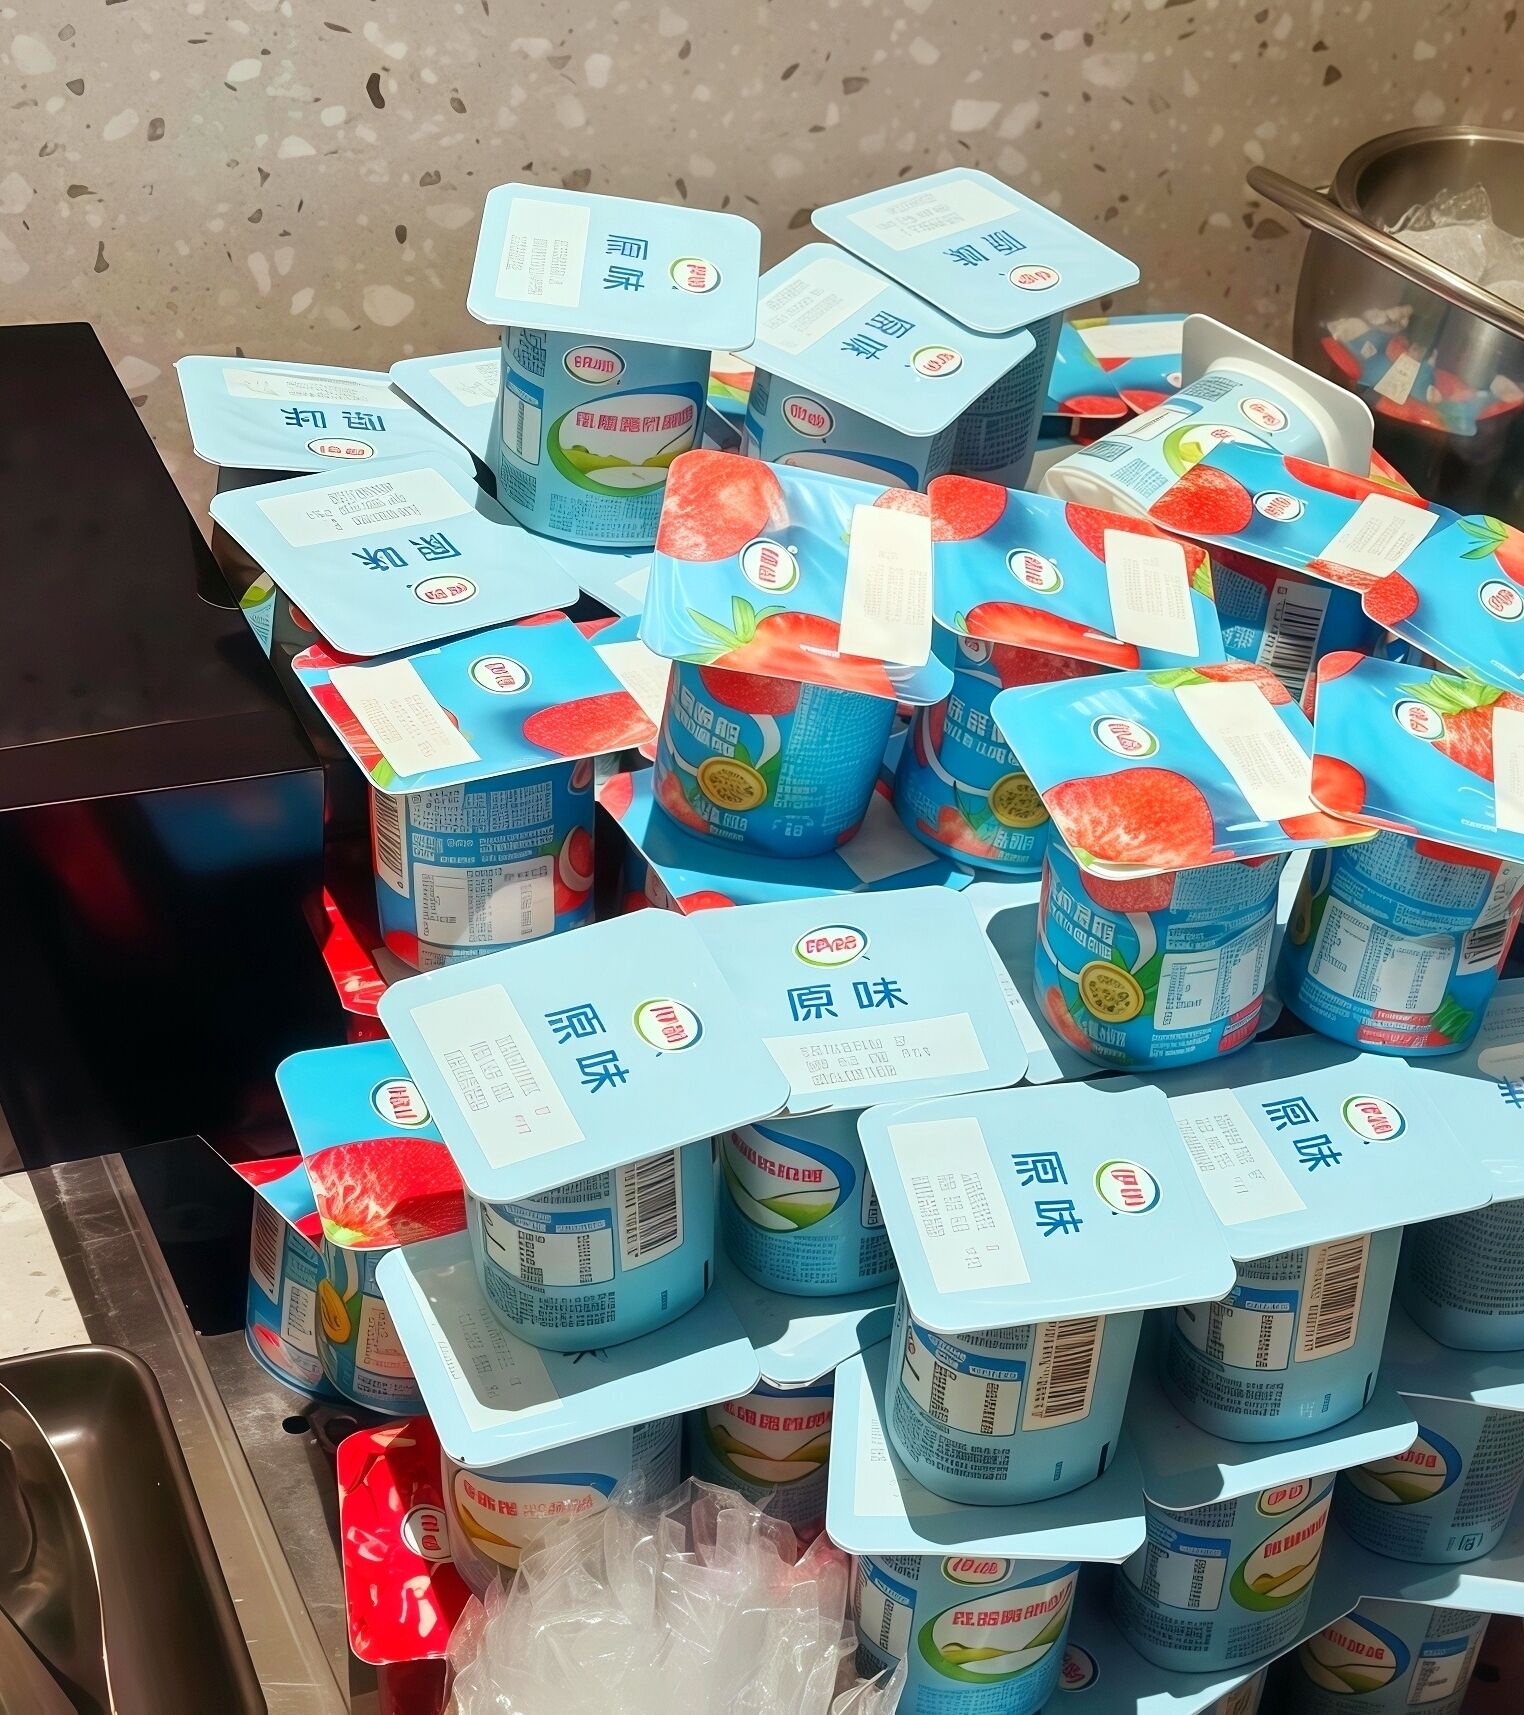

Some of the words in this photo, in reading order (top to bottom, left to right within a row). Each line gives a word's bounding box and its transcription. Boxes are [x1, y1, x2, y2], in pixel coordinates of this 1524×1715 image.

[787, 976, 908, 1022] 原味
[544, 1003, 630, 1095] 原味
[1261, 1096, 1343, 1172] 原味
[1011, 1152, 1084, 1238] 原味
